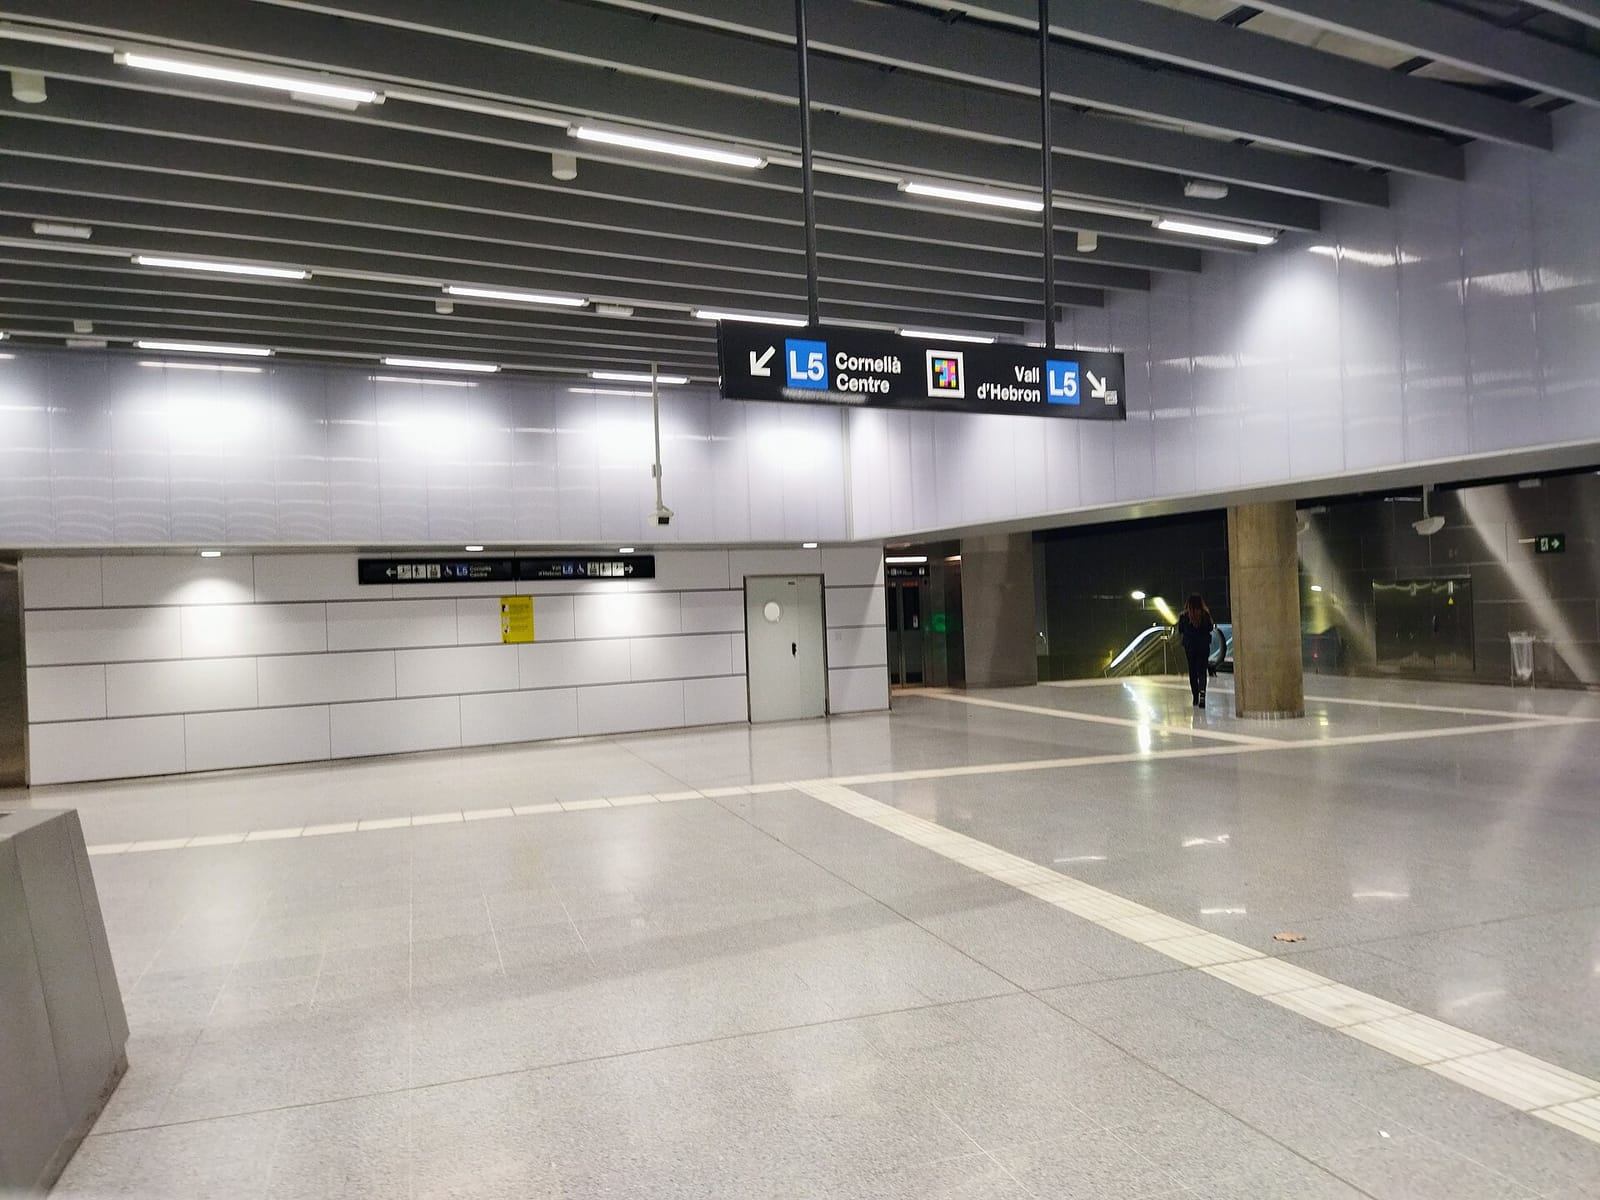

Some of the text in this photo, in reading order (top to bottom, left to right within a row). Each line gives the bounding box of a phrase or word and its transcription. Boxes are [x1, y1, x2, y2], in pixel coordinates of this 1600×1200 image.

[789, 350, 825, 382] L5
[835, 352, 902, 374] Cornellà
[836, 373, 890, 394] Centre
[1014, 365, 1040, 384] Vall
[1049, 370, 1078, 397] L5
[977, 382, 1041, 403] d'Hebron
